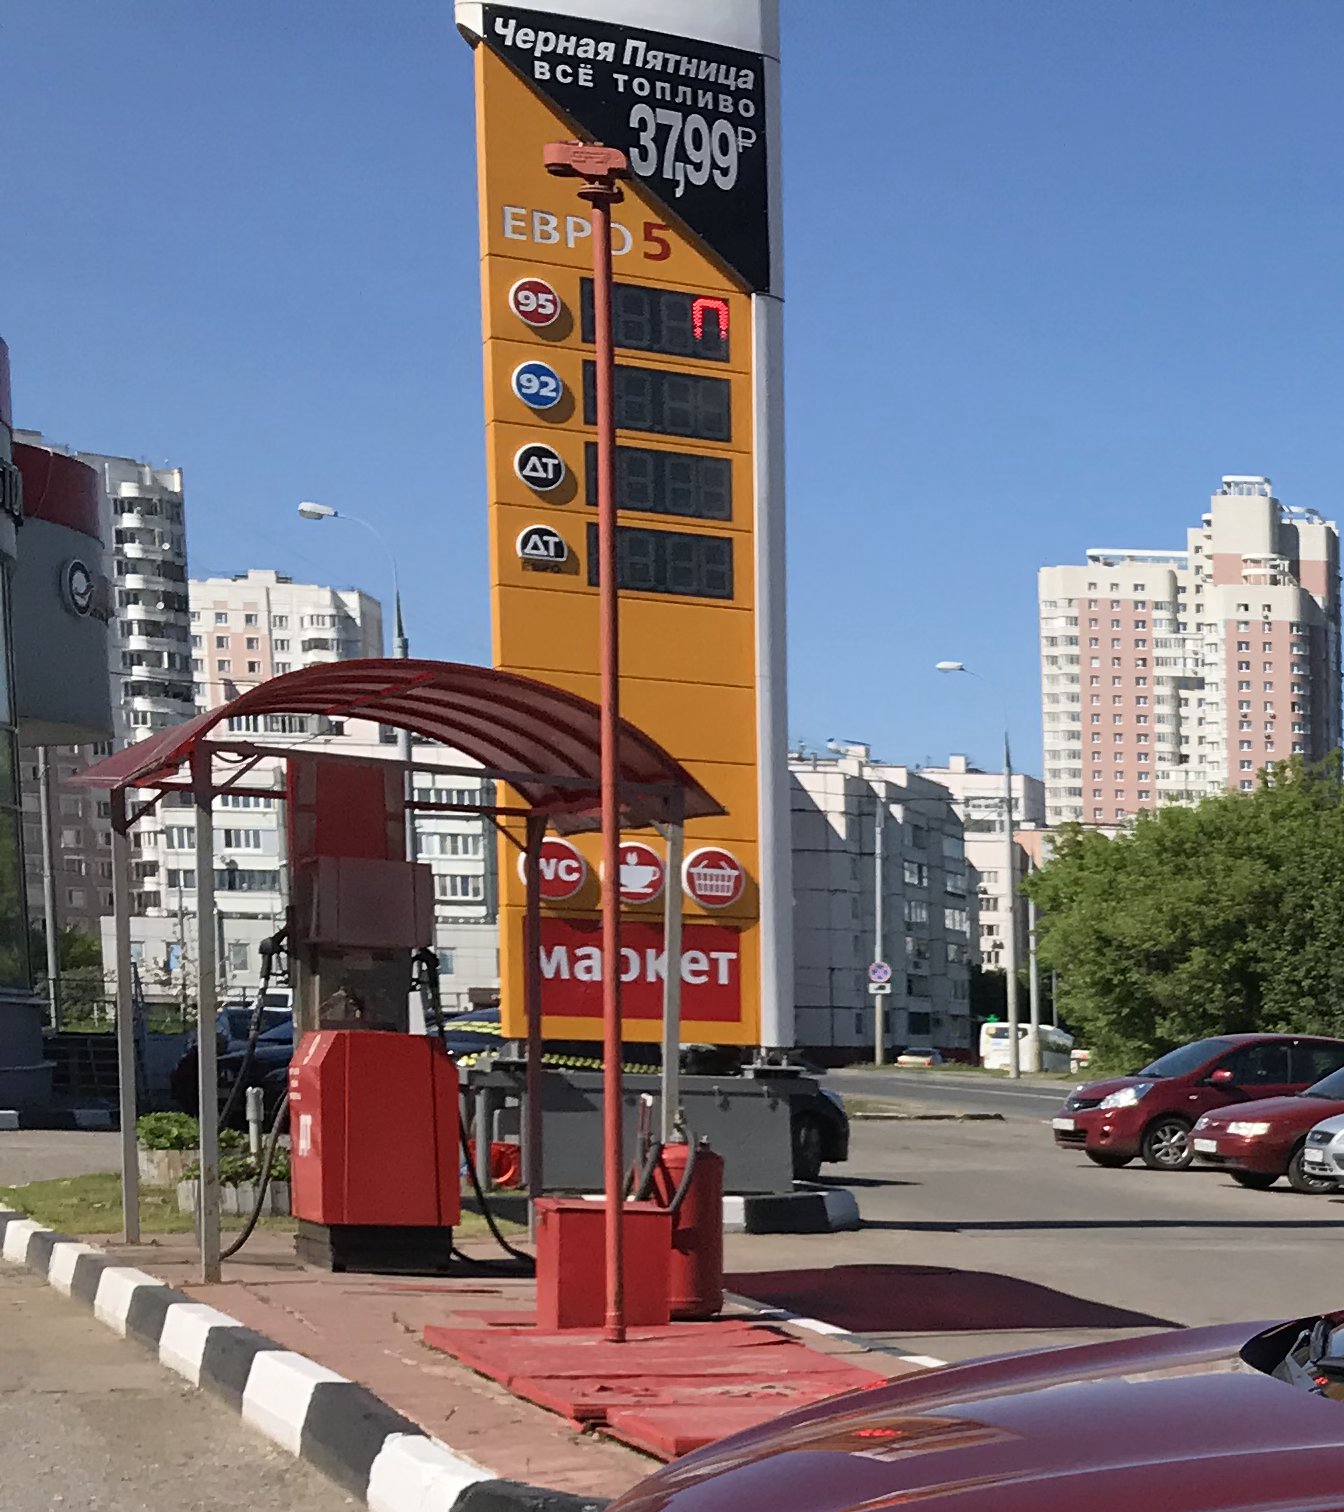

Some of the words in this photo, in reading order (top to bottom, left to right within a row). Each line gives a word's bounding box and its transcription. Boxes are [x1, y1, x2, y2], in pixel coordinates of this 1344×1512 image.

[494, 17, 616, 62] Черная
[622, 38, 754, 90] Пятница
[533, 60, 594, 87] ВСЁ
[612, 73, 755, 118] ТОПЛИВО
[643, 221, 672, 262] 5
[518, 290, 555, 315] 95
[519, 373, 557, 398] 92
